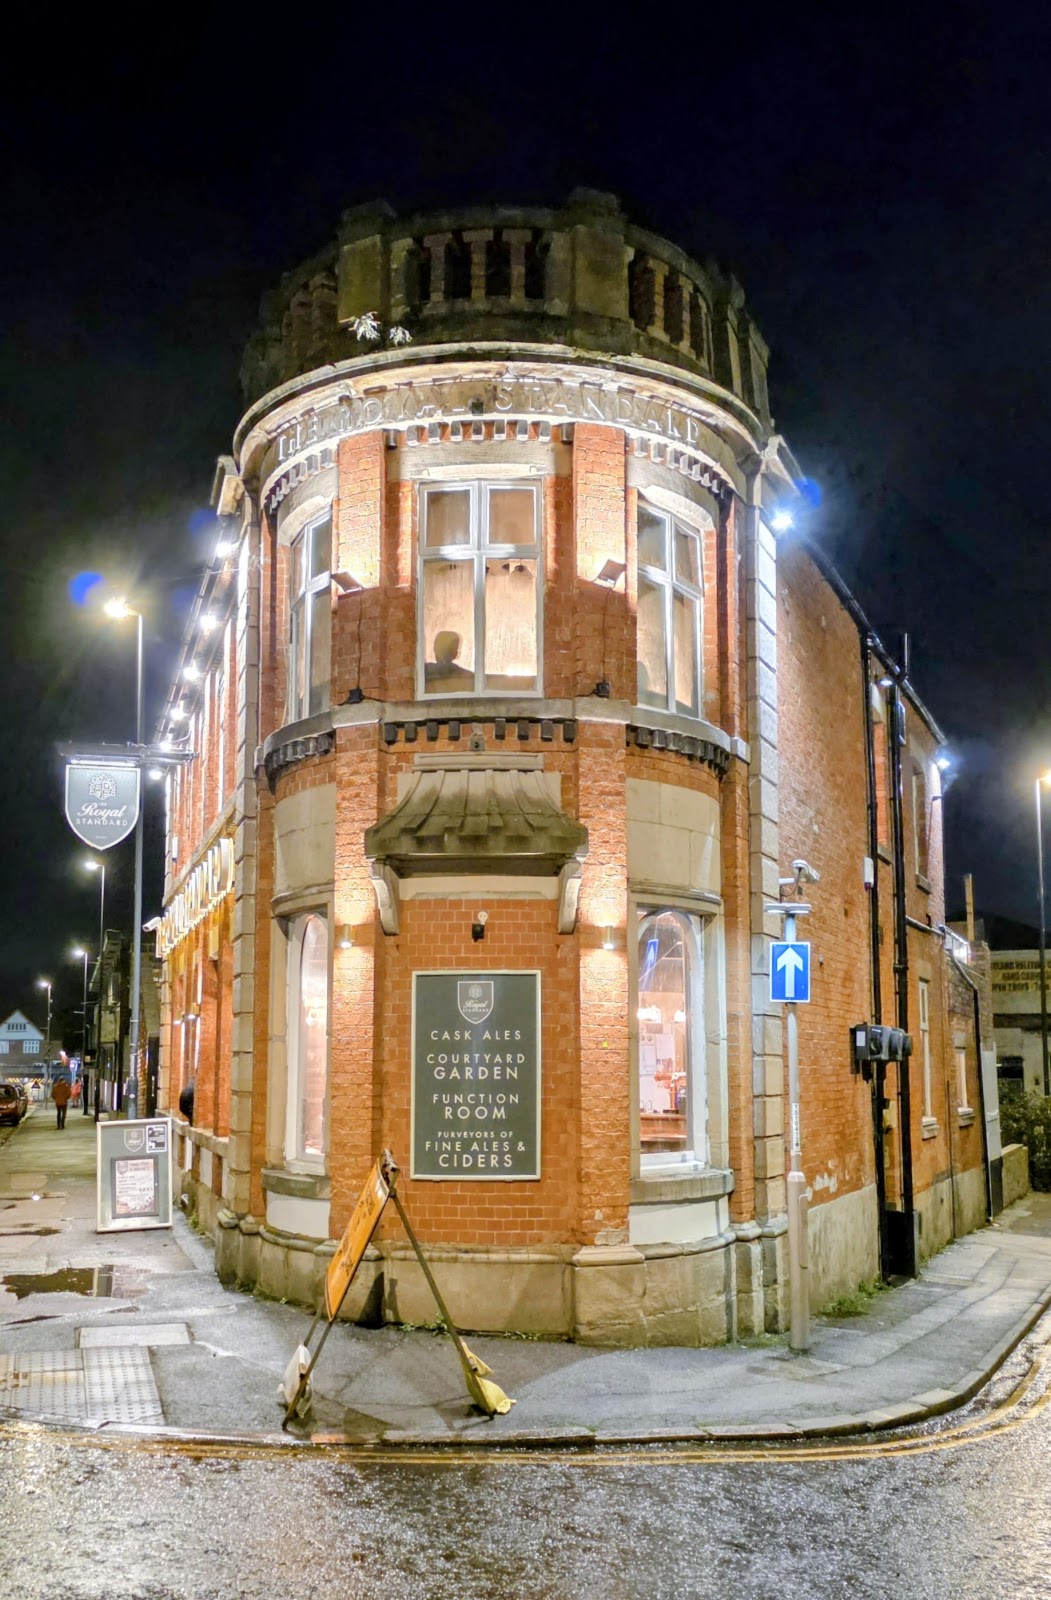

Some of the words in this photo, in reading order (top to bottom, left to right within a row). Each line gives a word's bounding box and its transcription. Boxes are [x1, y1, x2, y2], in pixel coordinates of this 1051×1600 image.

[494, 384, 700, 444] STANDARD
[77, 802, 127, 820] Royal
[430, 1030, 472, 1041] CASK
[482, 1030, 521, 1041] ALES
[426, 1053, 525, 1064] COURTYARD
[433, 1066, 518, 1080] GARDEN
[432, 1093, 519, 1104] FUNCTION
[444, 1106, 506, 1120] ROOM
[437, 1131, 495, 1139] PURVEYORS
[500, 1131, 514, 1139] OF
[425, 1141, 462, 1152] FINE
[470, 1141, 510, 1152] ALES
[517, 1141, 526, 1152] &
[438, 1153, 513, 1168] CIDERS
